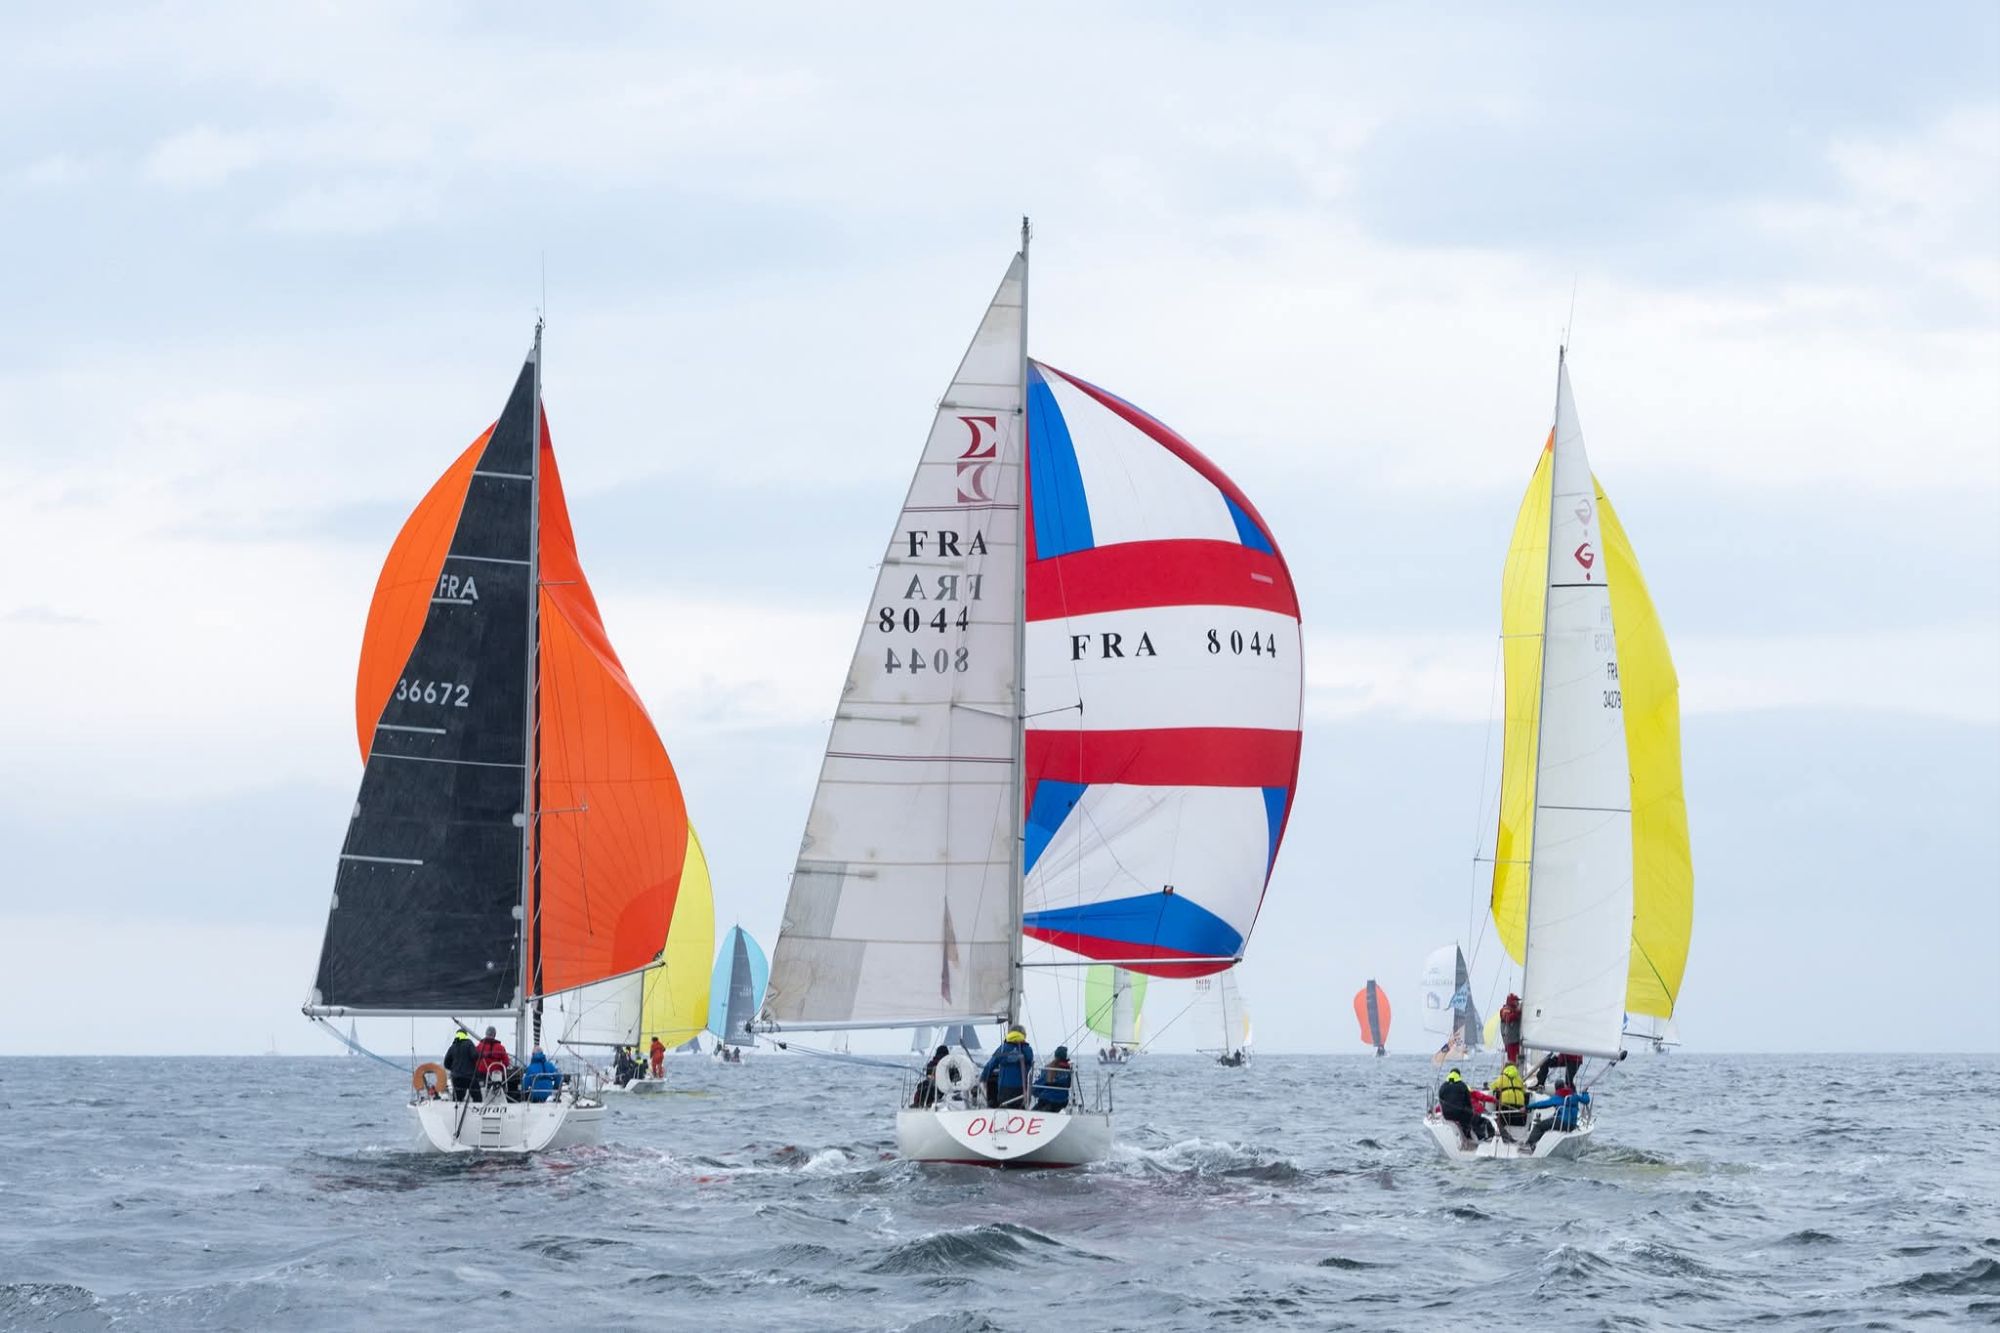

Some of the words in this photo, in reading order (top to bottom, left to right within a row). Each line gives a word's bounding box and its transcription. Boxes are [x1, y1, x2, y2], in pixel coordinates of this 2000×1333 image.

[907, 530, 989, 557] FRA
[439, 574, 479, 600] FRA
[879, 606, 969, 633] 8044
[1070, 631, 1157, 661] FRA
[1207, 628, 1277, 658] 8044
[396, 678, 470, 708] 36672
